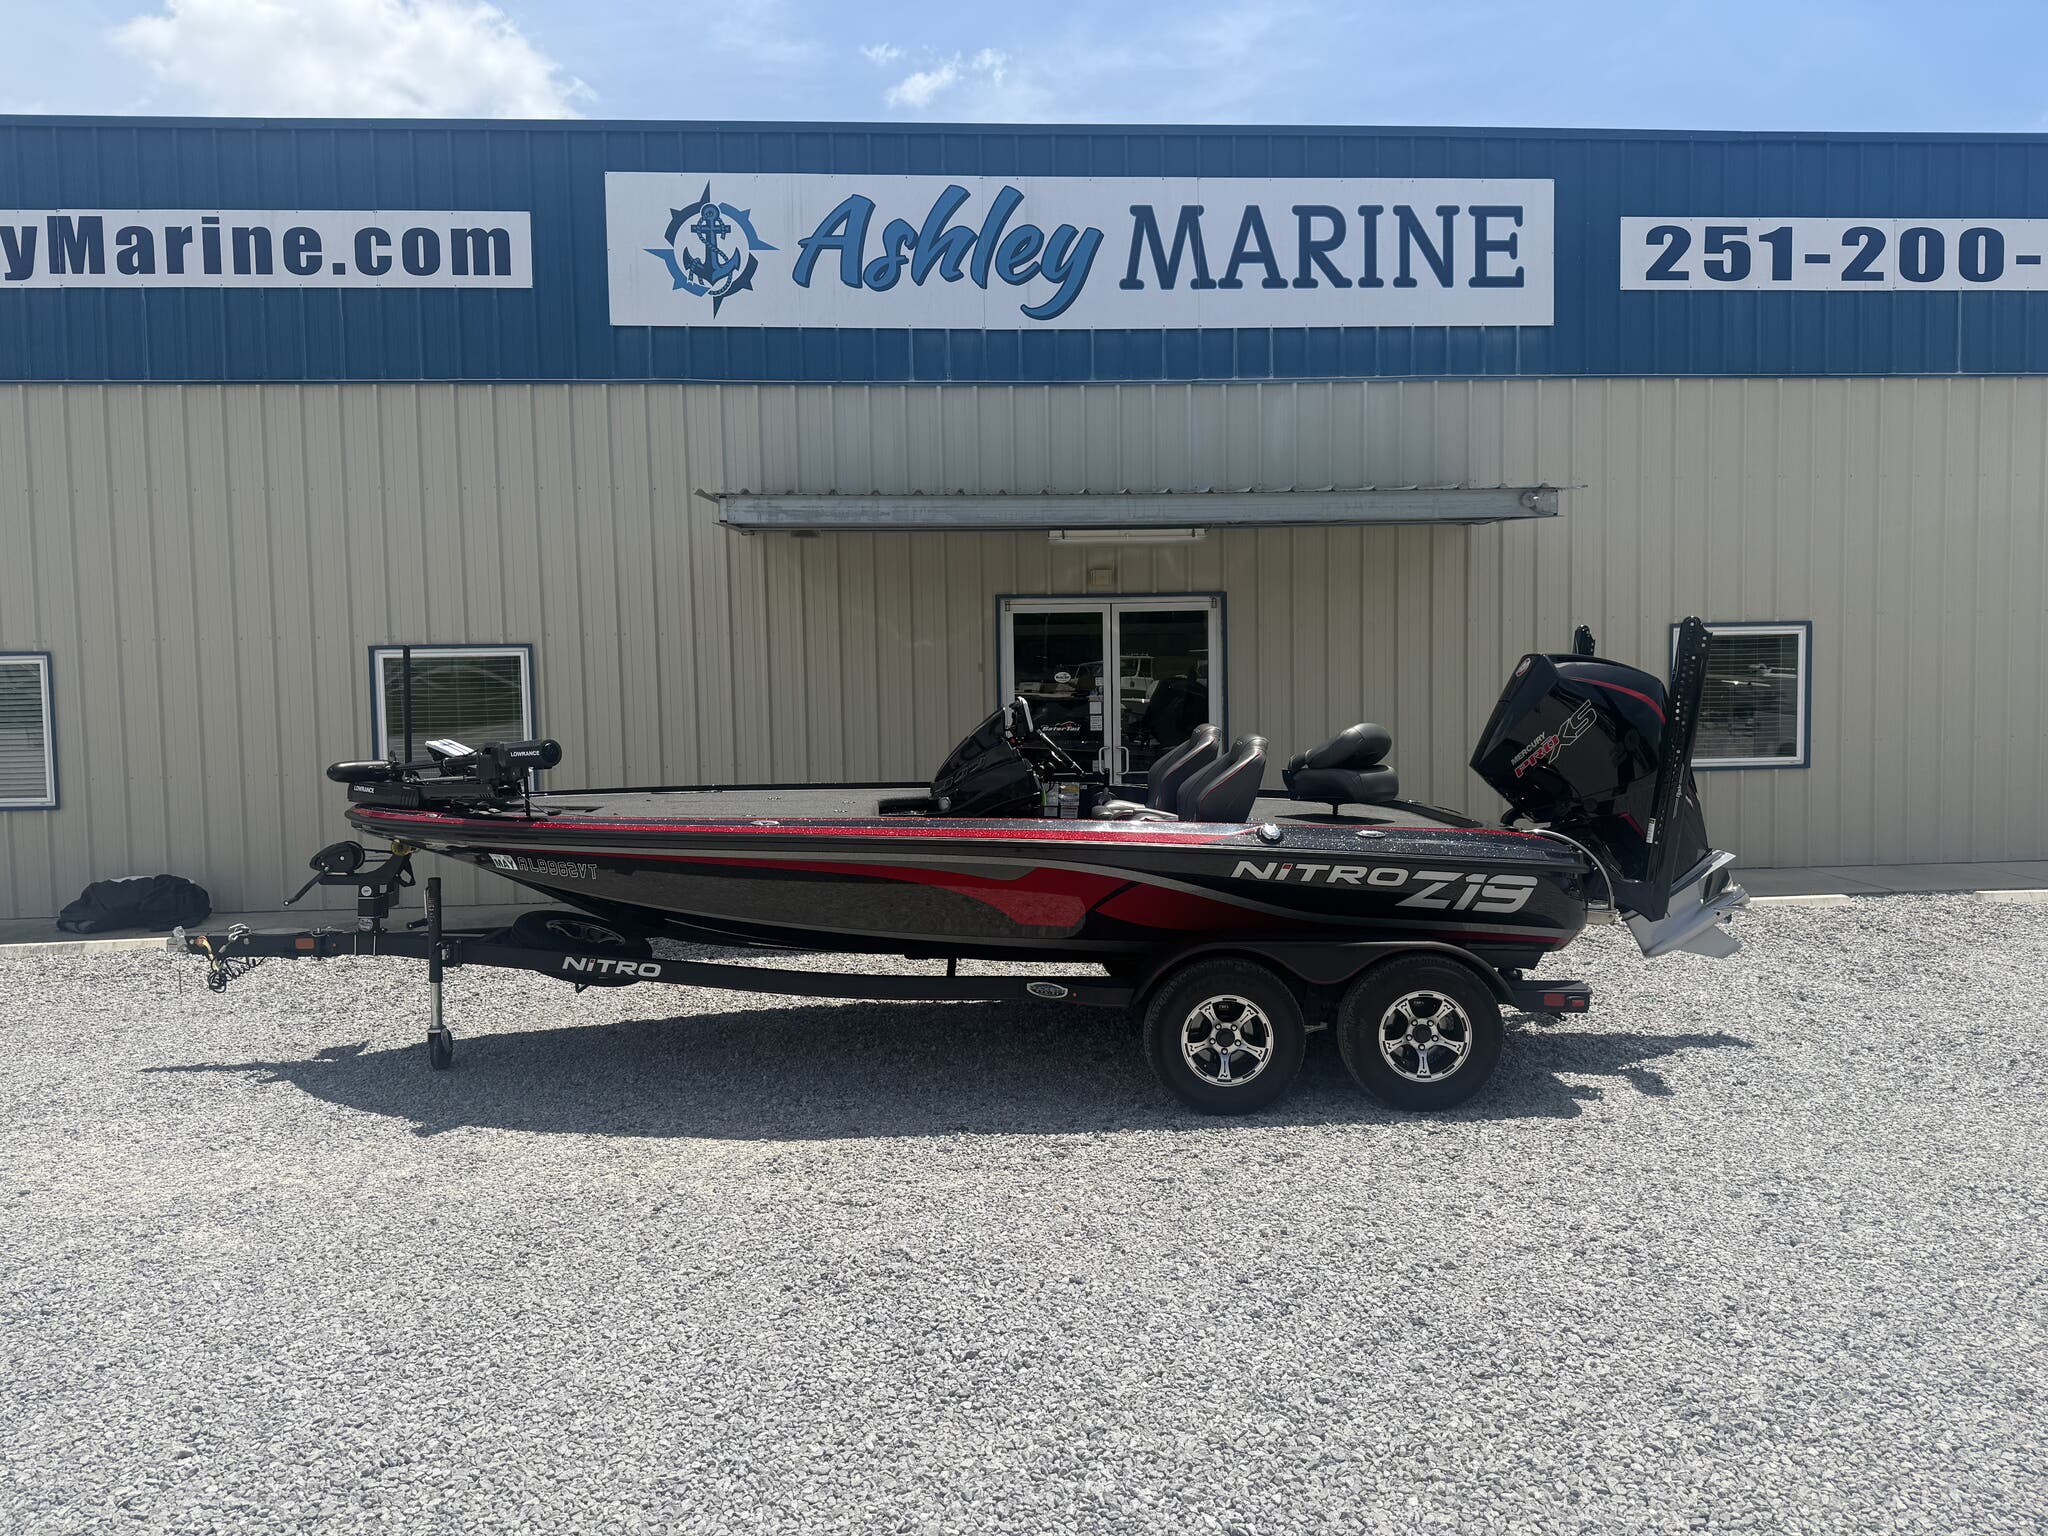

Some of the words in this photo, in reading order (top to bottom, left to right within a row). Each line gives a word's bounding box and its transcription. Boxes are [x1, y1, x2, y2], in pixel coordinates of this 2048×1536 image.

[0, 214, 512, 281] yMarine.com
[791, 184, 1105, 321] Ashley
[1119, 204, 1526, 291] MARINE
[1645, 225, 2042, 282] 251-200-
[1510, 731, 1546, 766] MERCURY
[353, 785, 375, 794] LOWRANCE
[493, 858, 516, 870] MAY
[1395, 870, 1538, 914] Z19
